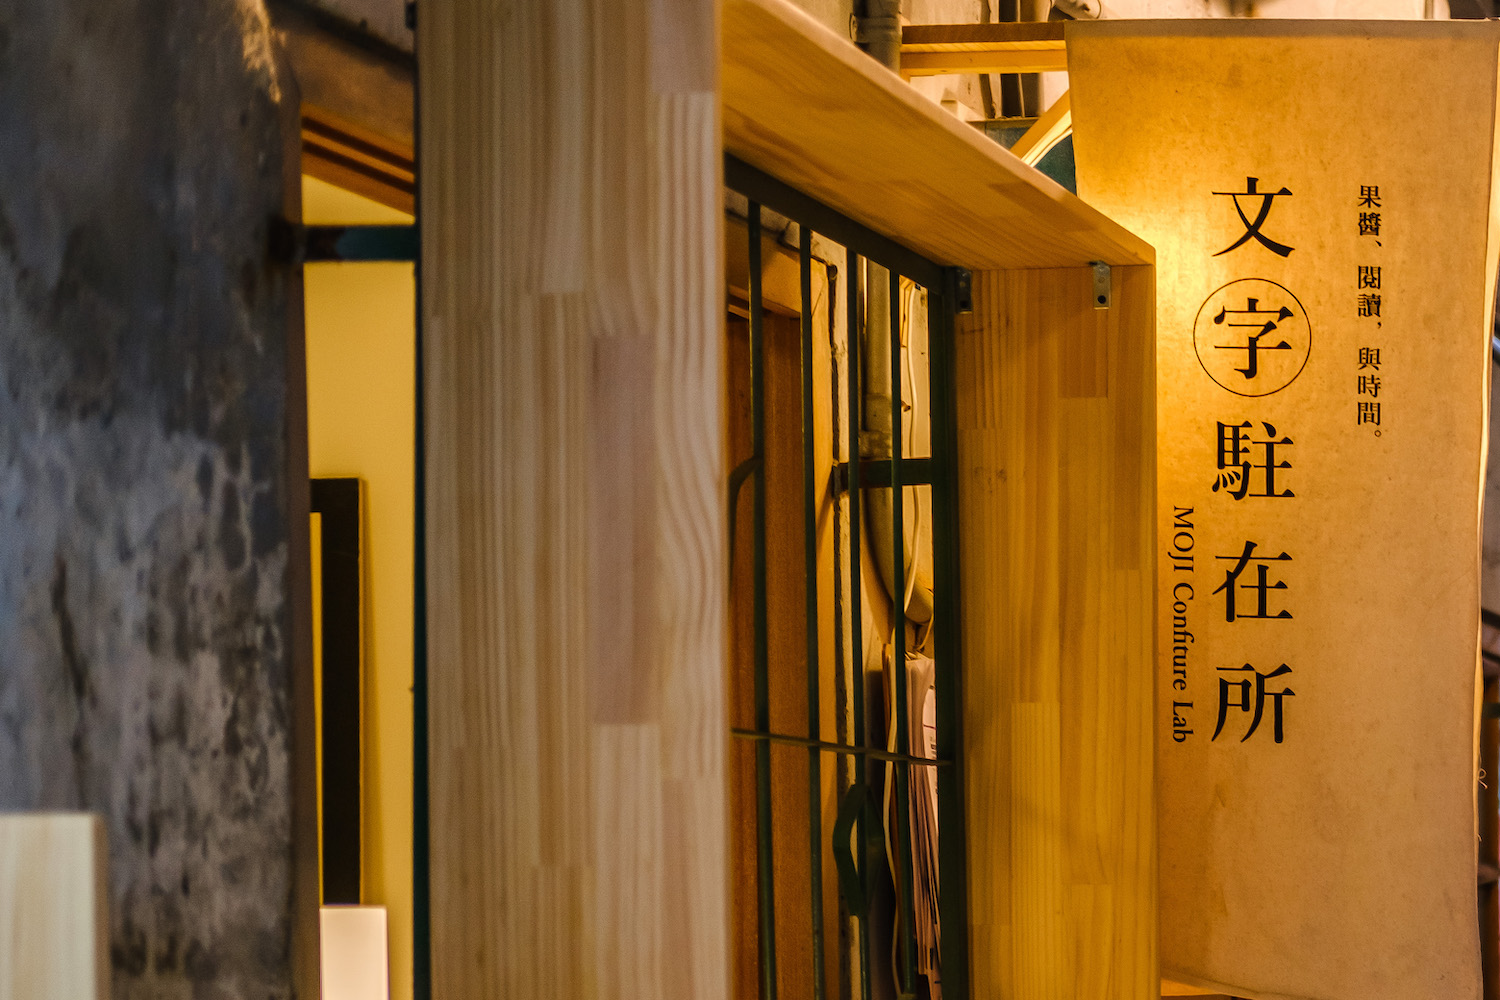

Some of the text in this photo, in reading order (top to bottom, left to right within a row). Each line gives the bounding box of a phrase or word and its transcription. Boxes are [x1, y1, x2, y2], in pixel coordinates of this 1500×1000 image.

[1168, 505, 1195, 743] MOJI Confiture Lab
[1211, 176, 1296, 744] 文字駐在所
